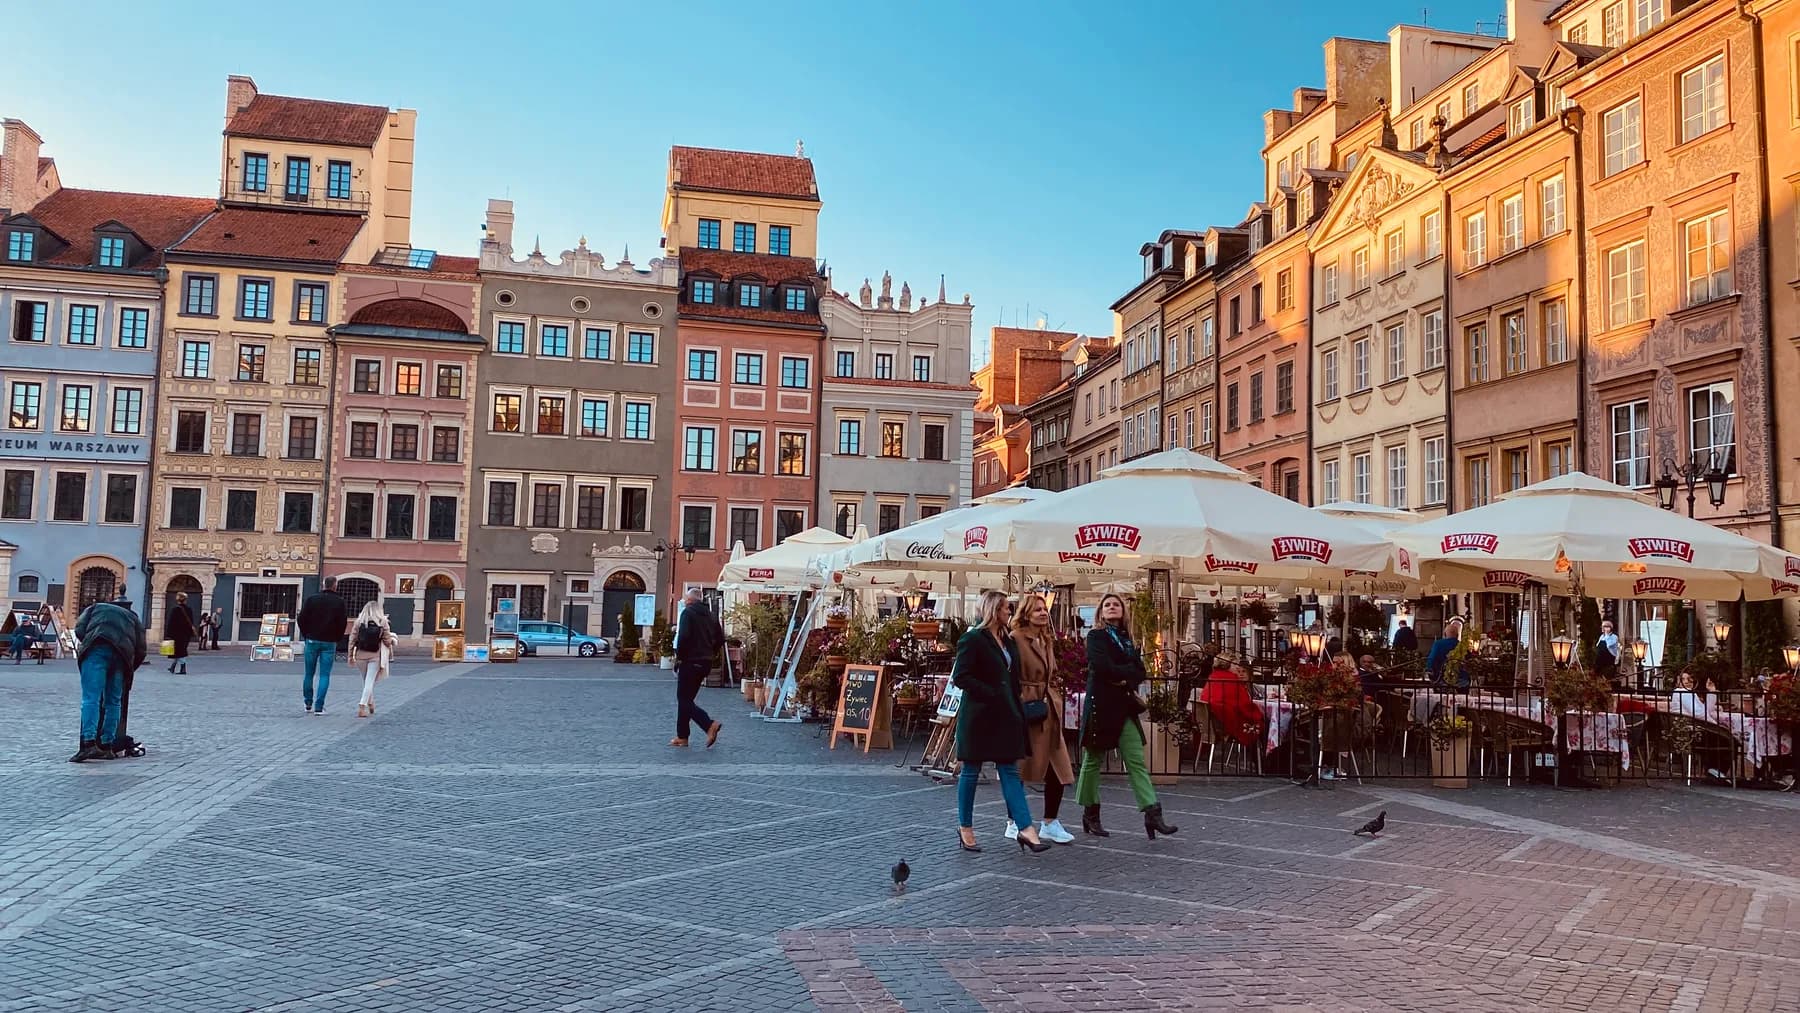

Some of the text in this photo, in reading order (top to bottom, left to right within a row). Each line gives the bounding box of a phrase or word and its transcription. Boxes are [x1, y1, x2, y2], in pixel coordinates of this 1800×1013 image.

[0, 439, 139, 454] EUM WARSZAWY
[1084, 526, 1134, 542] ŻYWIEC
[1448, 534, 1494, 547] ŻYWIEC
[1279, 538, 1325, 555] ŻYWIEC
[1635, 538, 1686, 554] ŻYWIEC
